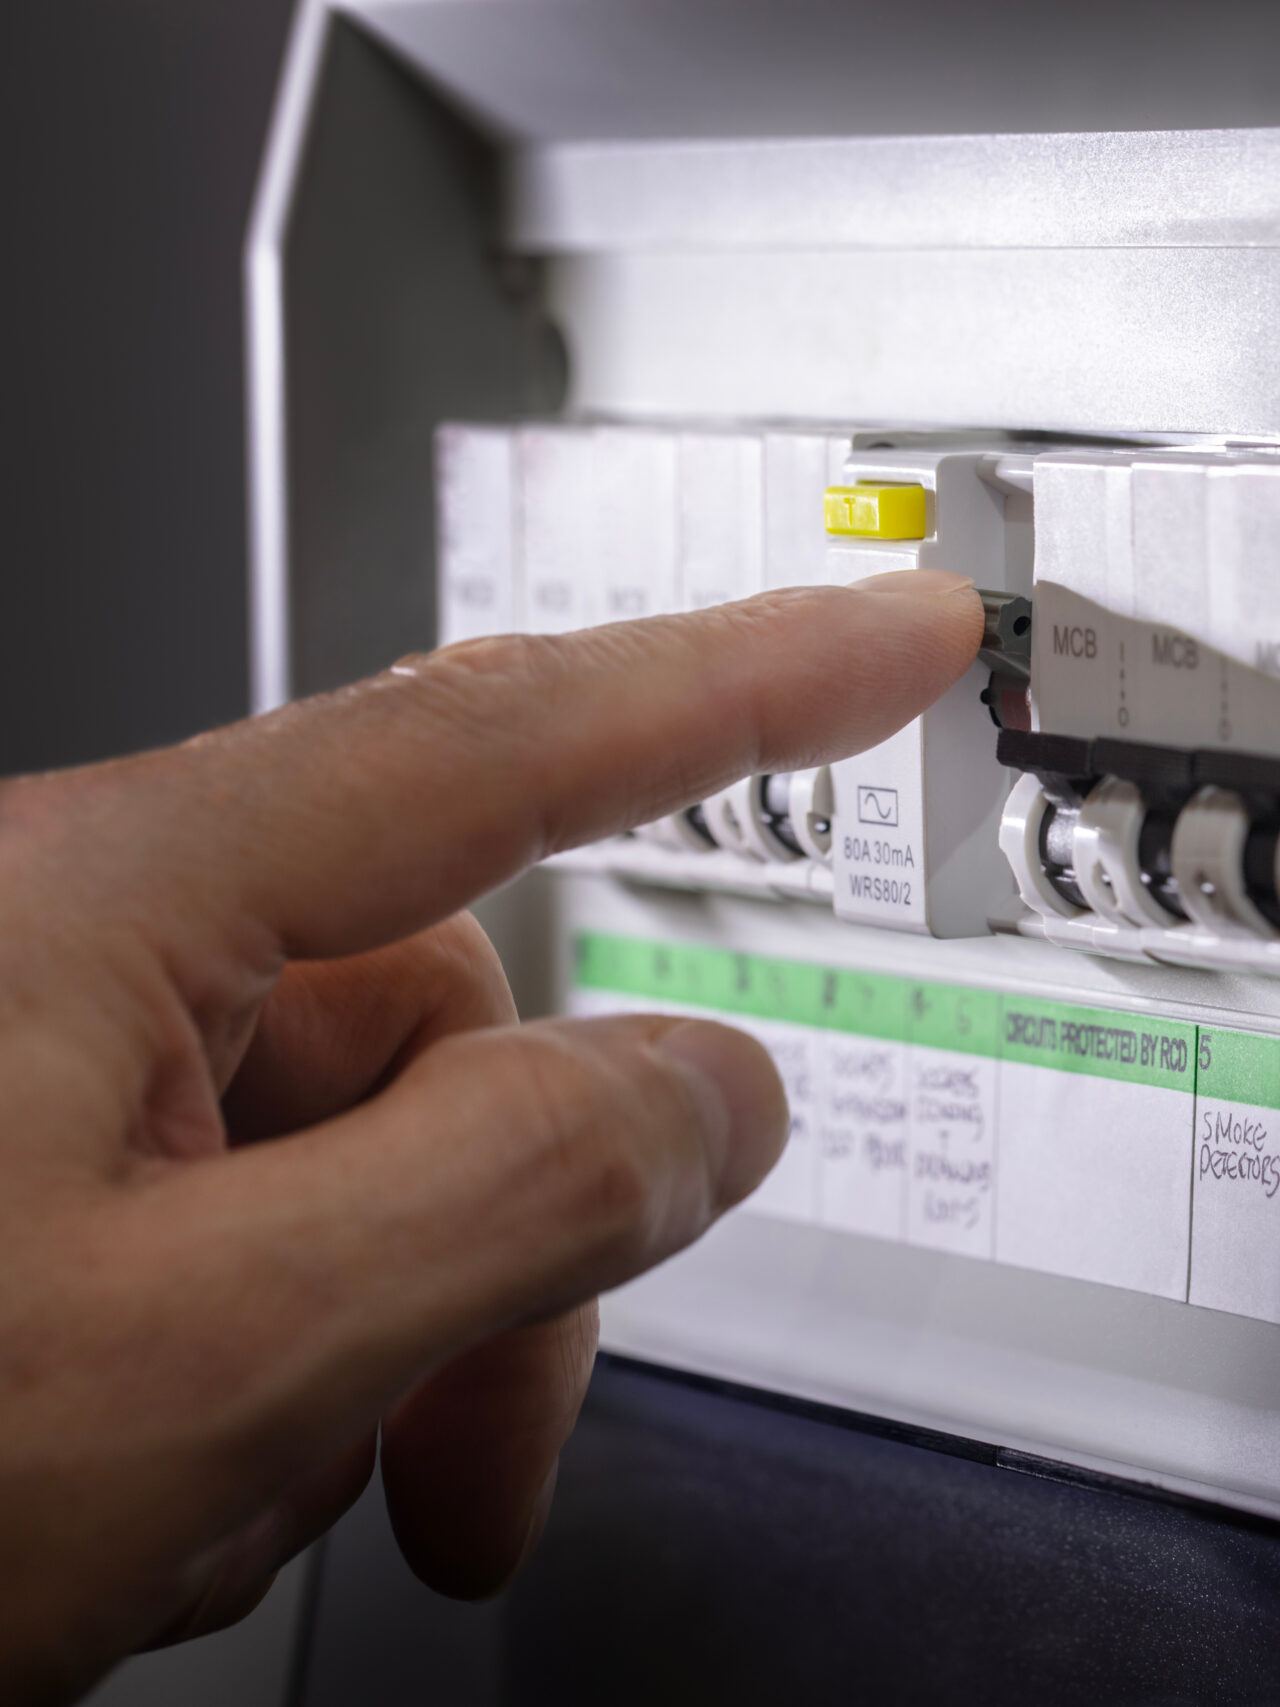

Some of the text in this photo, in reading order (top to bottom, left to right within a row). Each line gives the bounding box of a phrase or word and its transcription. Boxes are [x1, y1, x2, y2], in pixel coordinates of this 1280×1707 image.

[1053, 625, 1098, 660] MCB
[1152, 633, 1199, 671] MCB
[844, 836, 915, 868] 80A 30mA
[849, 873, 912, 906] WRS80/2
[1006, 1012, 1188, 1073] CIRCUITS PROTECTED BY RCD
[1199, 1034, 1212, 1071] 5
[1203, 1111, 1267, 1152] SMOKE
[1200, 1144, 1280, 1198] DETECTORS
